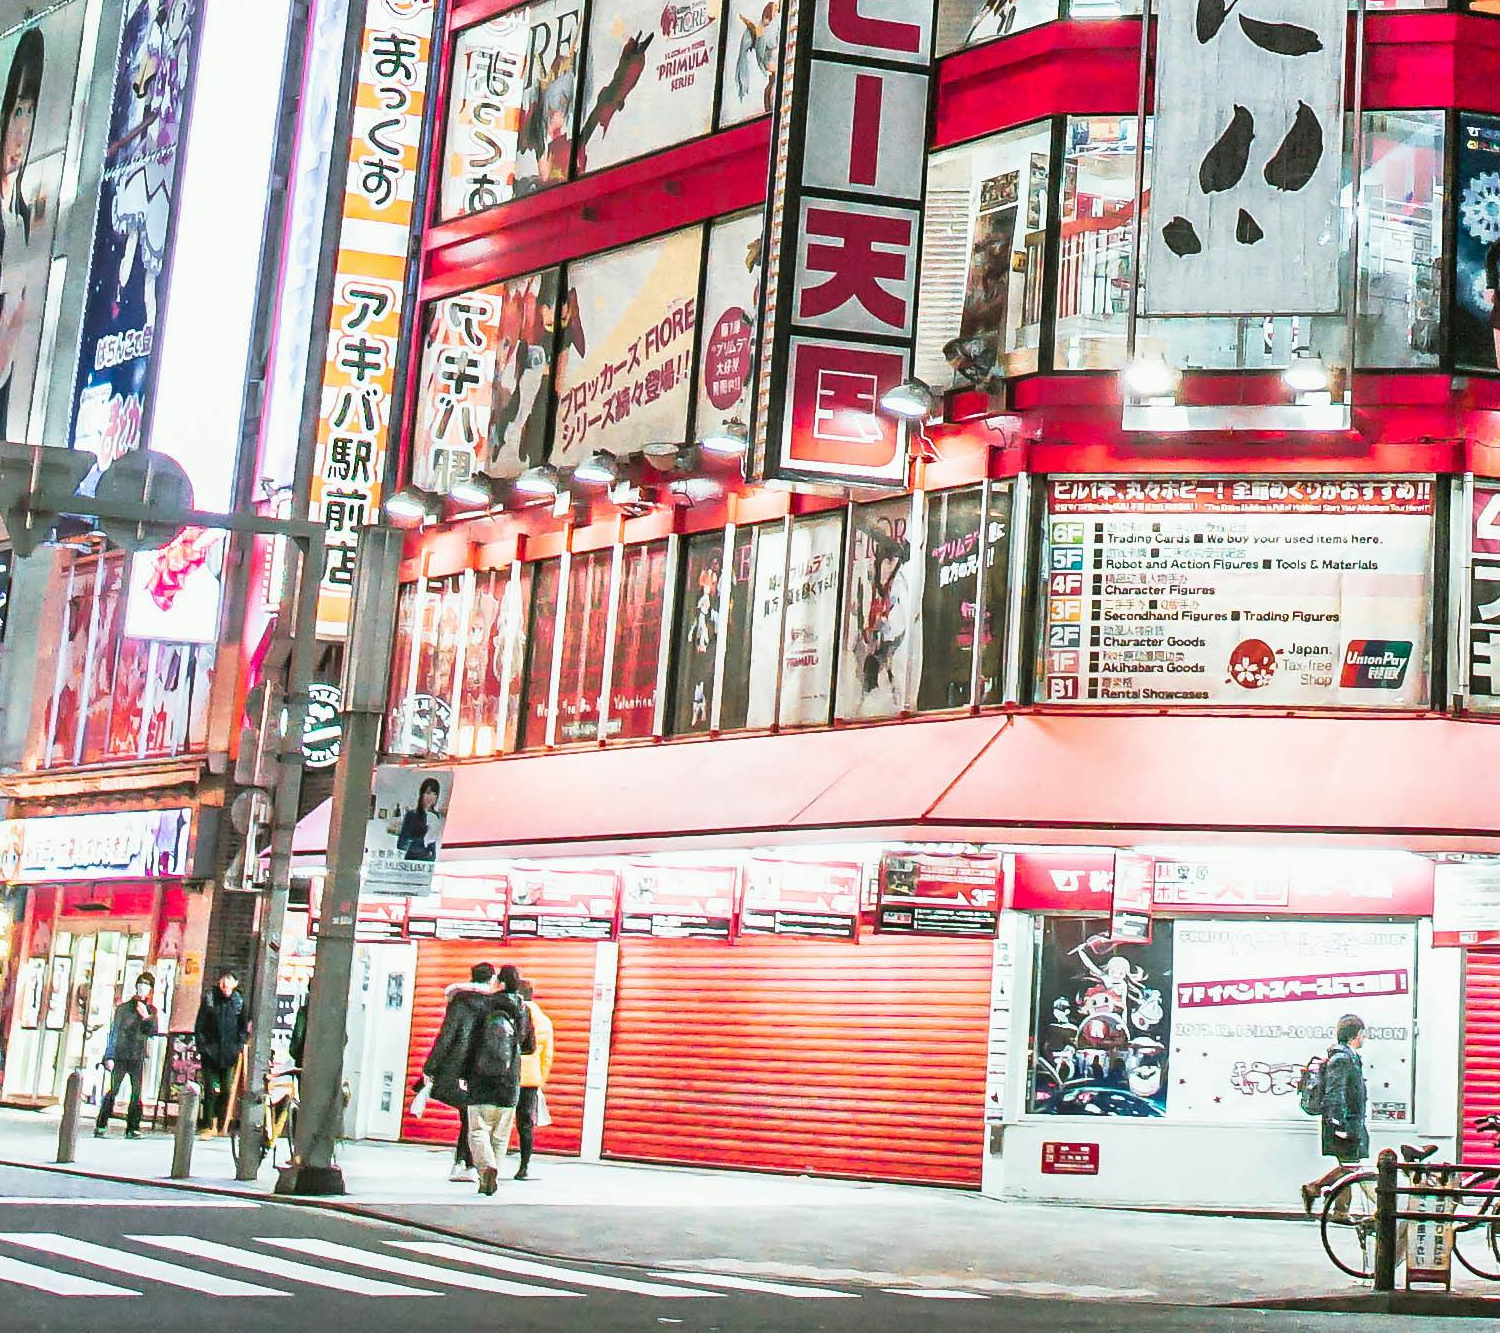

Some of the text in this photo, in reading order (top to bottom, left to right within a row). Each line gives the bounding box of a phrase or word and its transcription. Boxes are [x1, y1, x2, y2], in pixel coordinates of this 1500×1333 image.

[360, 31, 418, 209] まっくす
[643, 295, 699, 366] FIORE
[323, 284, 395, 589] アキバ駅前店
[1053, 524, 1084, 544] 6F
[1107, 533, 1383, 546] Trading Cards We buy your used items here.
[1052, 550, 1083, 570] 5F
[1106, 558, 1379, 571] Robot and Action Figures Tools & Materials
[1052, 576, 1083, 595] 4F
[1105, 585, 1216, 597] Character Figures
[1051, 600, 1082, 620] 3F
[1104, 610, 1340, 623] Secondhand Figures Trading Figures
[1050, 626, 1080, 646] 2F
[1103, 636, 1206, 648] Character Goods
[1287, 642, 1333, 658] Japan.
[1346, 649, 1407, 669] UnionPay
[1050, 652, 1077, 672] 1F
[1102, 661, 1206, 673] Akihabara Goods
[1048, 677, 1076, 698] B1
[1300, 674, 1333, 689] Shop
[1100, 687, 1210, 700] Rental Showcases
[970, 888, 996, 908] 3F
